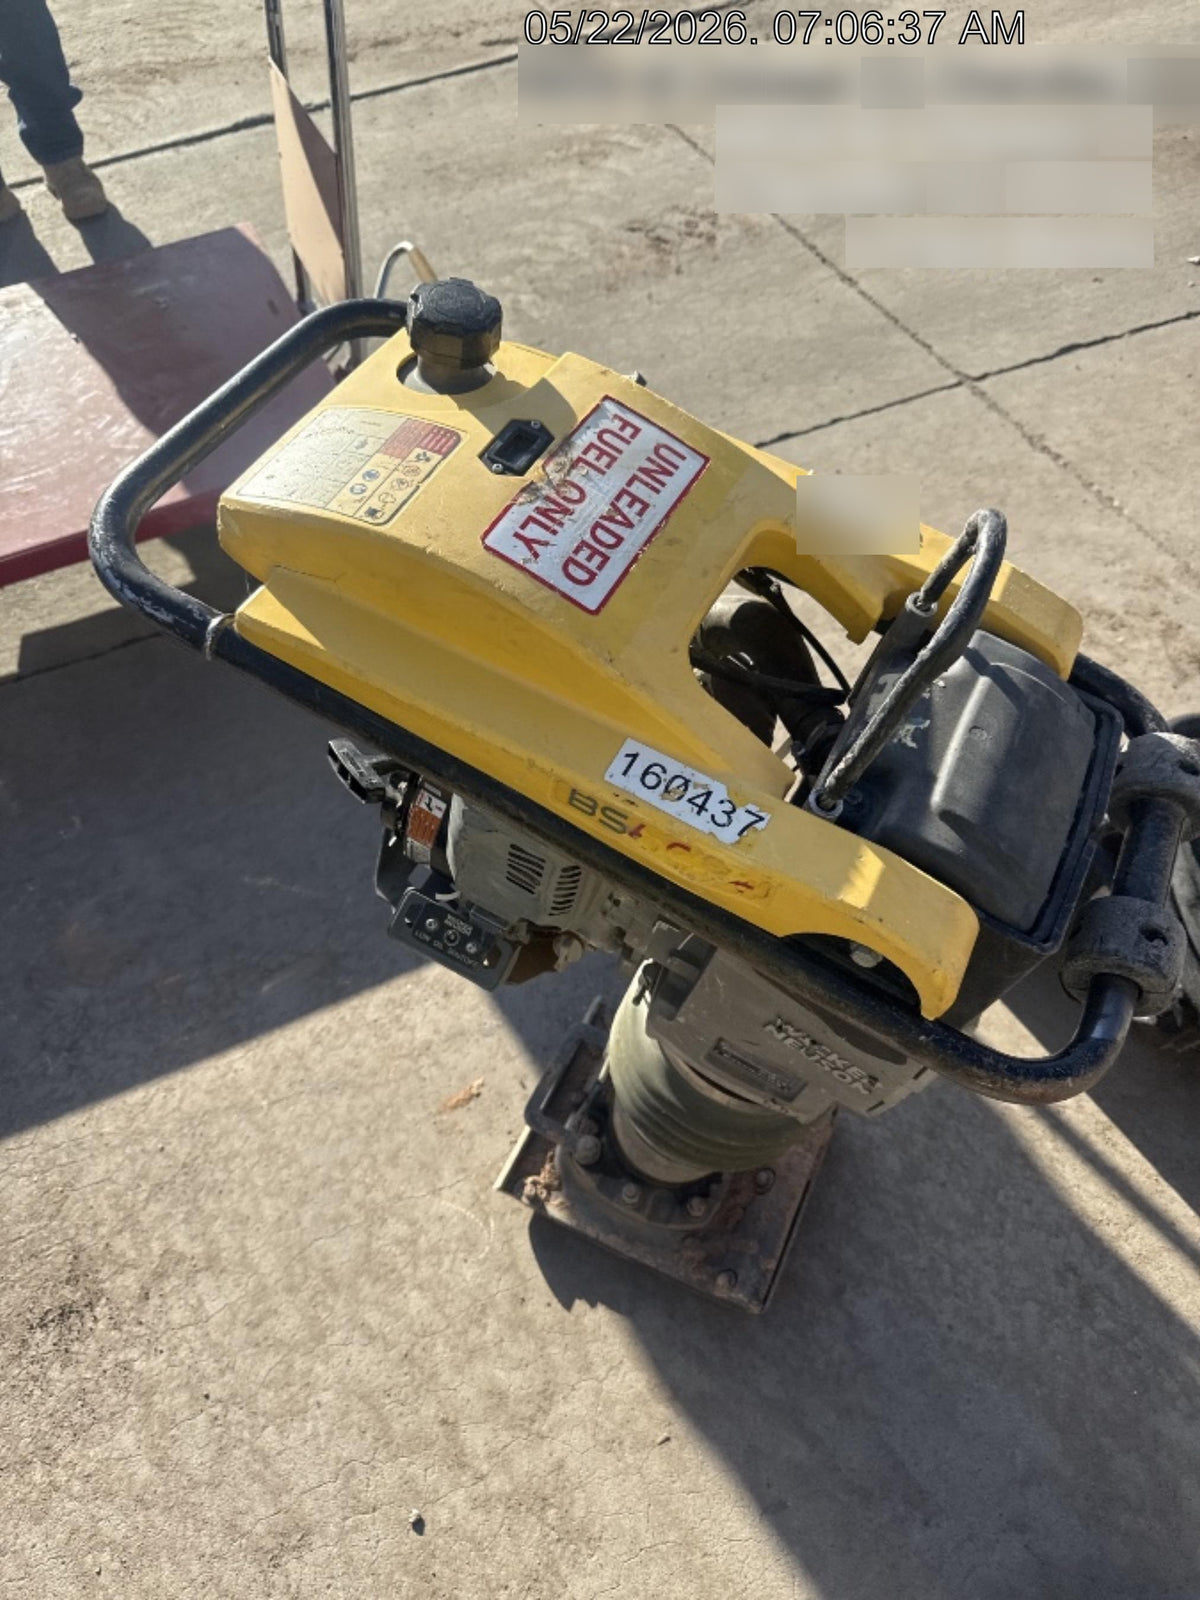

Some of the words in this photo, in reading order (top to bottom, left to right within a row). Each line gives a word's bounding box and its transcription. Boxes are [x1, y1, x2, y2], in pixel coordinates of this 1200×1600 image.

[570, 413, 643, 476] FUEL
[512, 478, 587, 560] ONLY
[562, 443, 687, 587] UNLEADED
[621, 751, 765, 837] 160437
